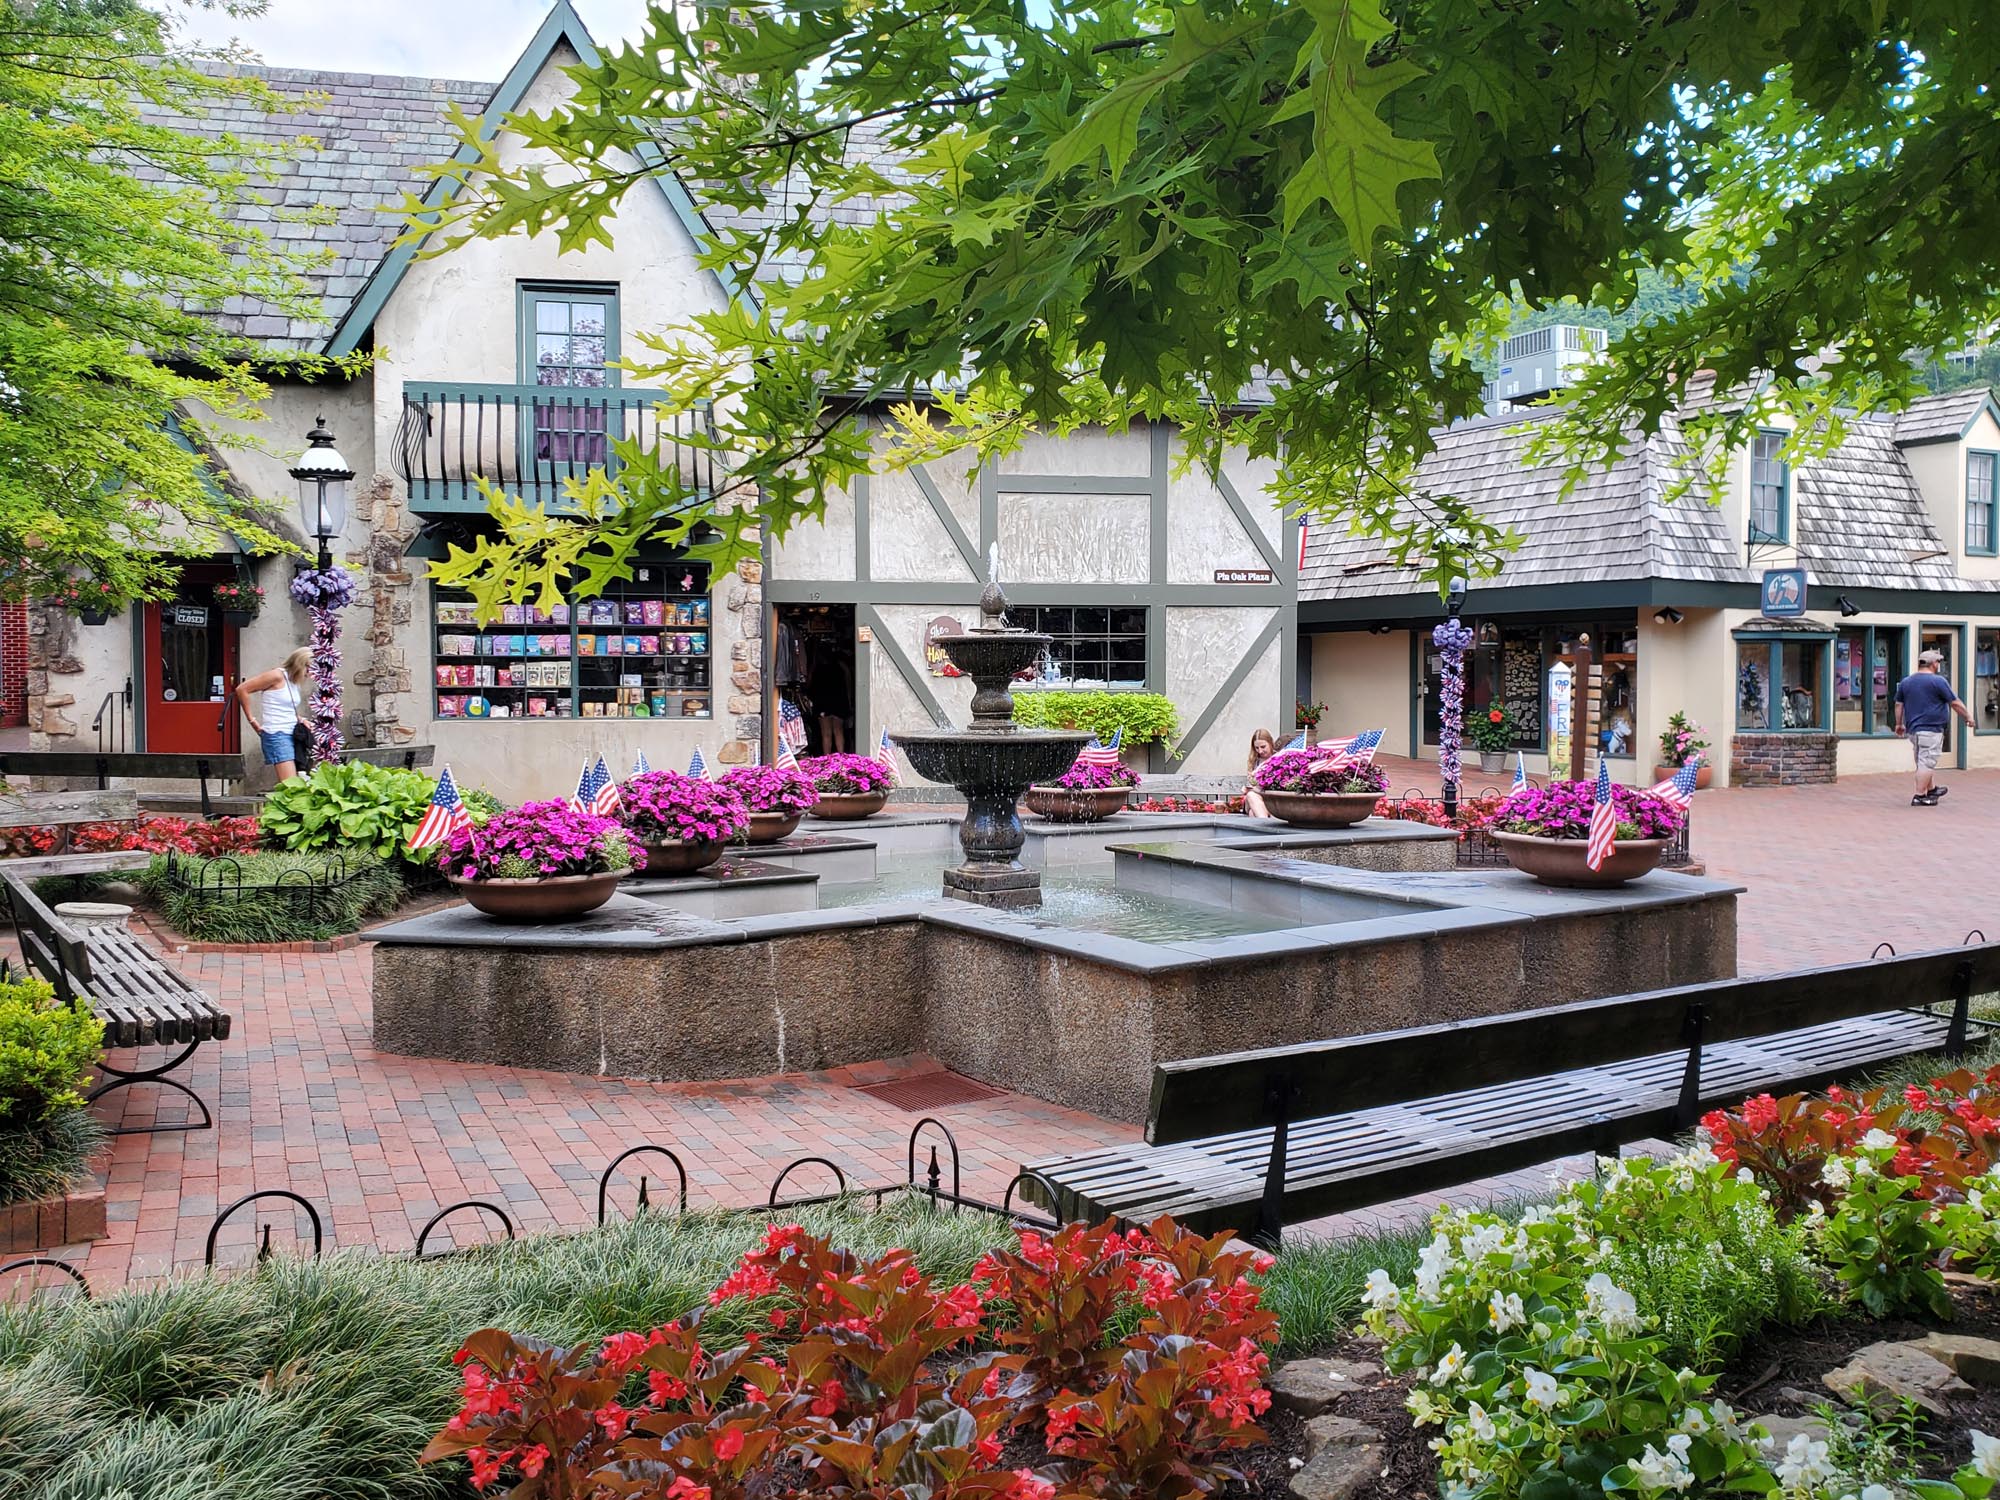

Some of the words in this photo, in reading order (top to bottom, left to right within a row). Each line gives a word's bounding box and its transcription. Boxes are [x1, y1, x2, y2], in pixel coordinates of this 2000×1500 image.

[1248, 573, 1269, 581] Plaza
[810, 592, 820, 600] 19
[178, 615, 204, 624] CLOSED
[930, 624, 949, 639] The
[926, 645, 949, 663] HAYL
[1557, 704, 1567, 757] FREE
